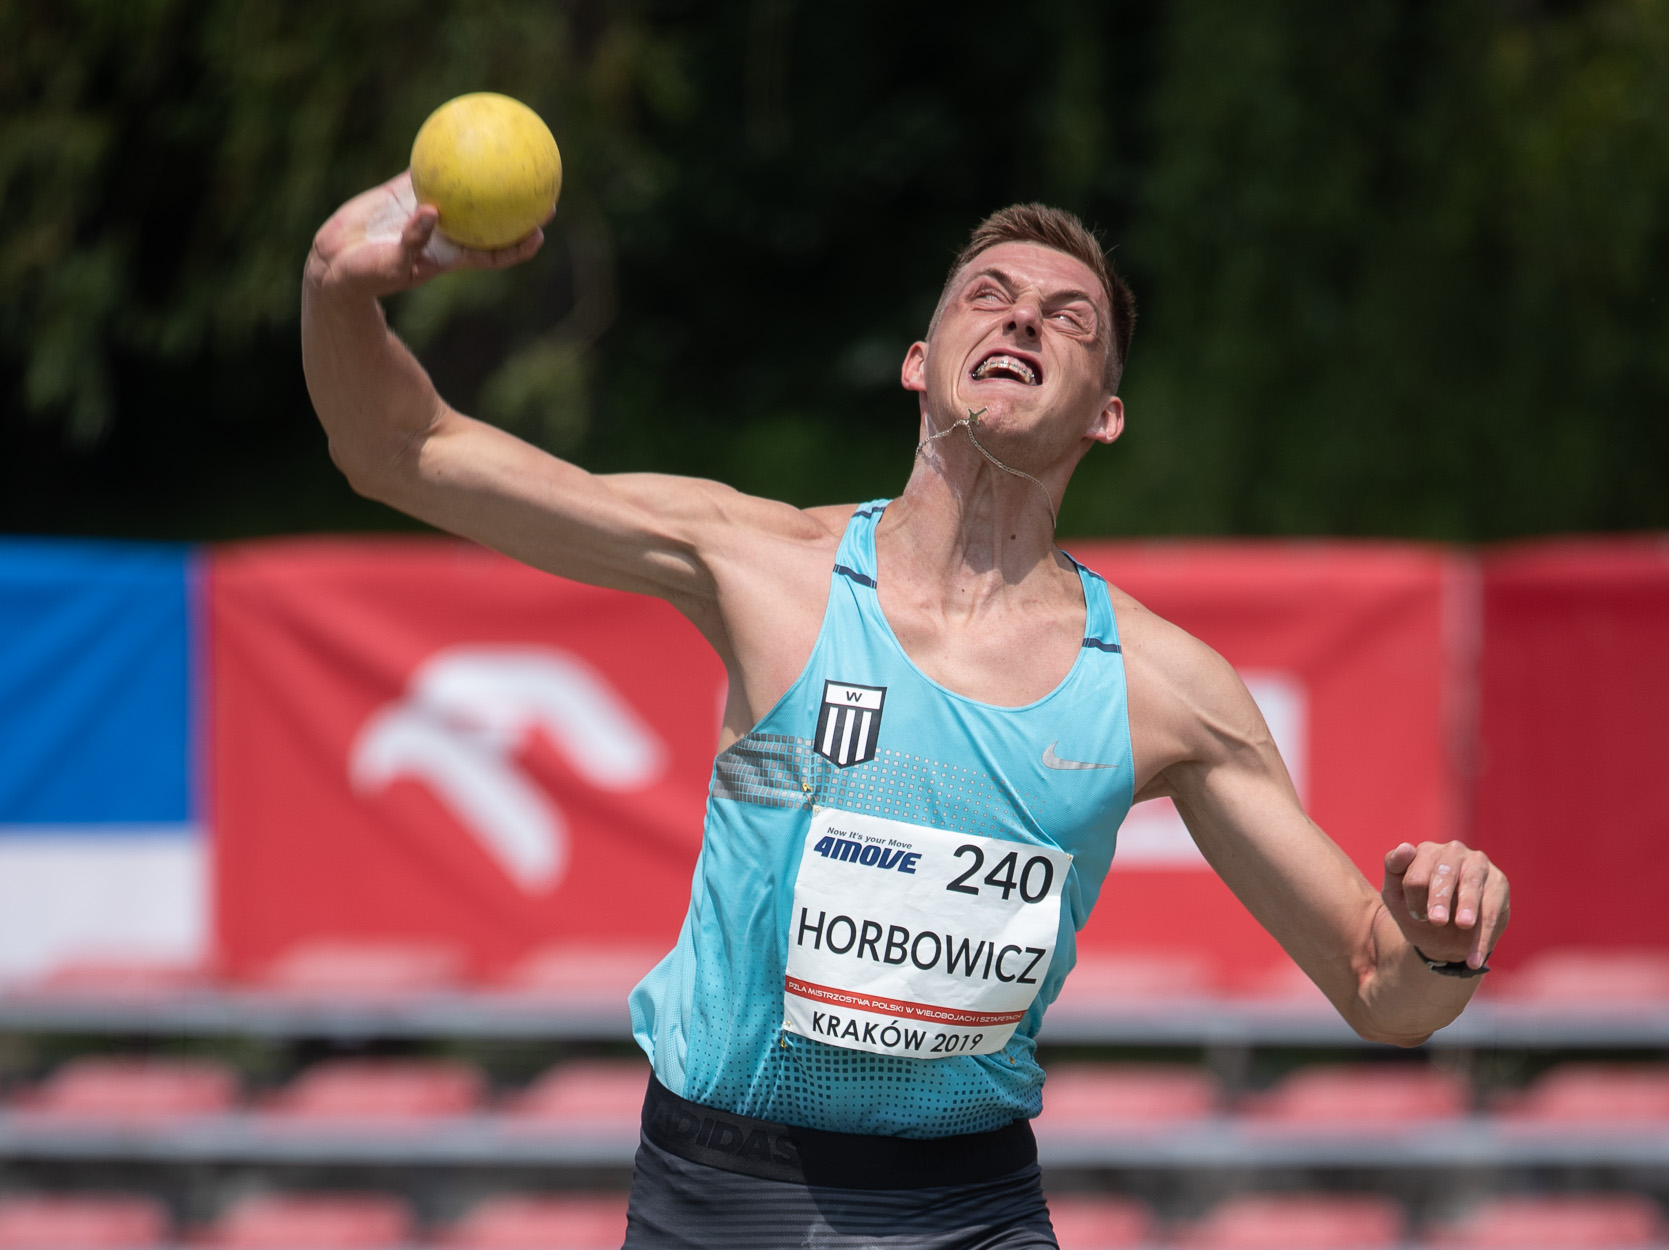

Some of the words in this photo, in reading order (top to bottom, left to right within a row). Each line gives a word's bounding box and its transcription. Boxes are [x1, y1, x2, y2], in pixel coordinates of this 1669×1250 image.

[845, 690, 862, 702] W
[813, 835, 922, 874] 4MOVE
[827, 827, 847, 837] Now
[849, 831, 863, 840] It's
[865, 836, 886, 844] your
[888, 839, 912, 849] Move
[946, 843, 1054, 904] 240
[797, 907, 1046, 985] HORBOWICZ
[789, 981, 807, 993] PZLA
[807, 988, 871, 1007] MISTRZOSTWA
[872, 1000, 904, 1012] POLSKI
[916, 1008, 975, 1022] WIELOBOJACH
[812, 1010, 927, 1052] KRAKÓW
[930, 1032, 984, 1053] 2019
